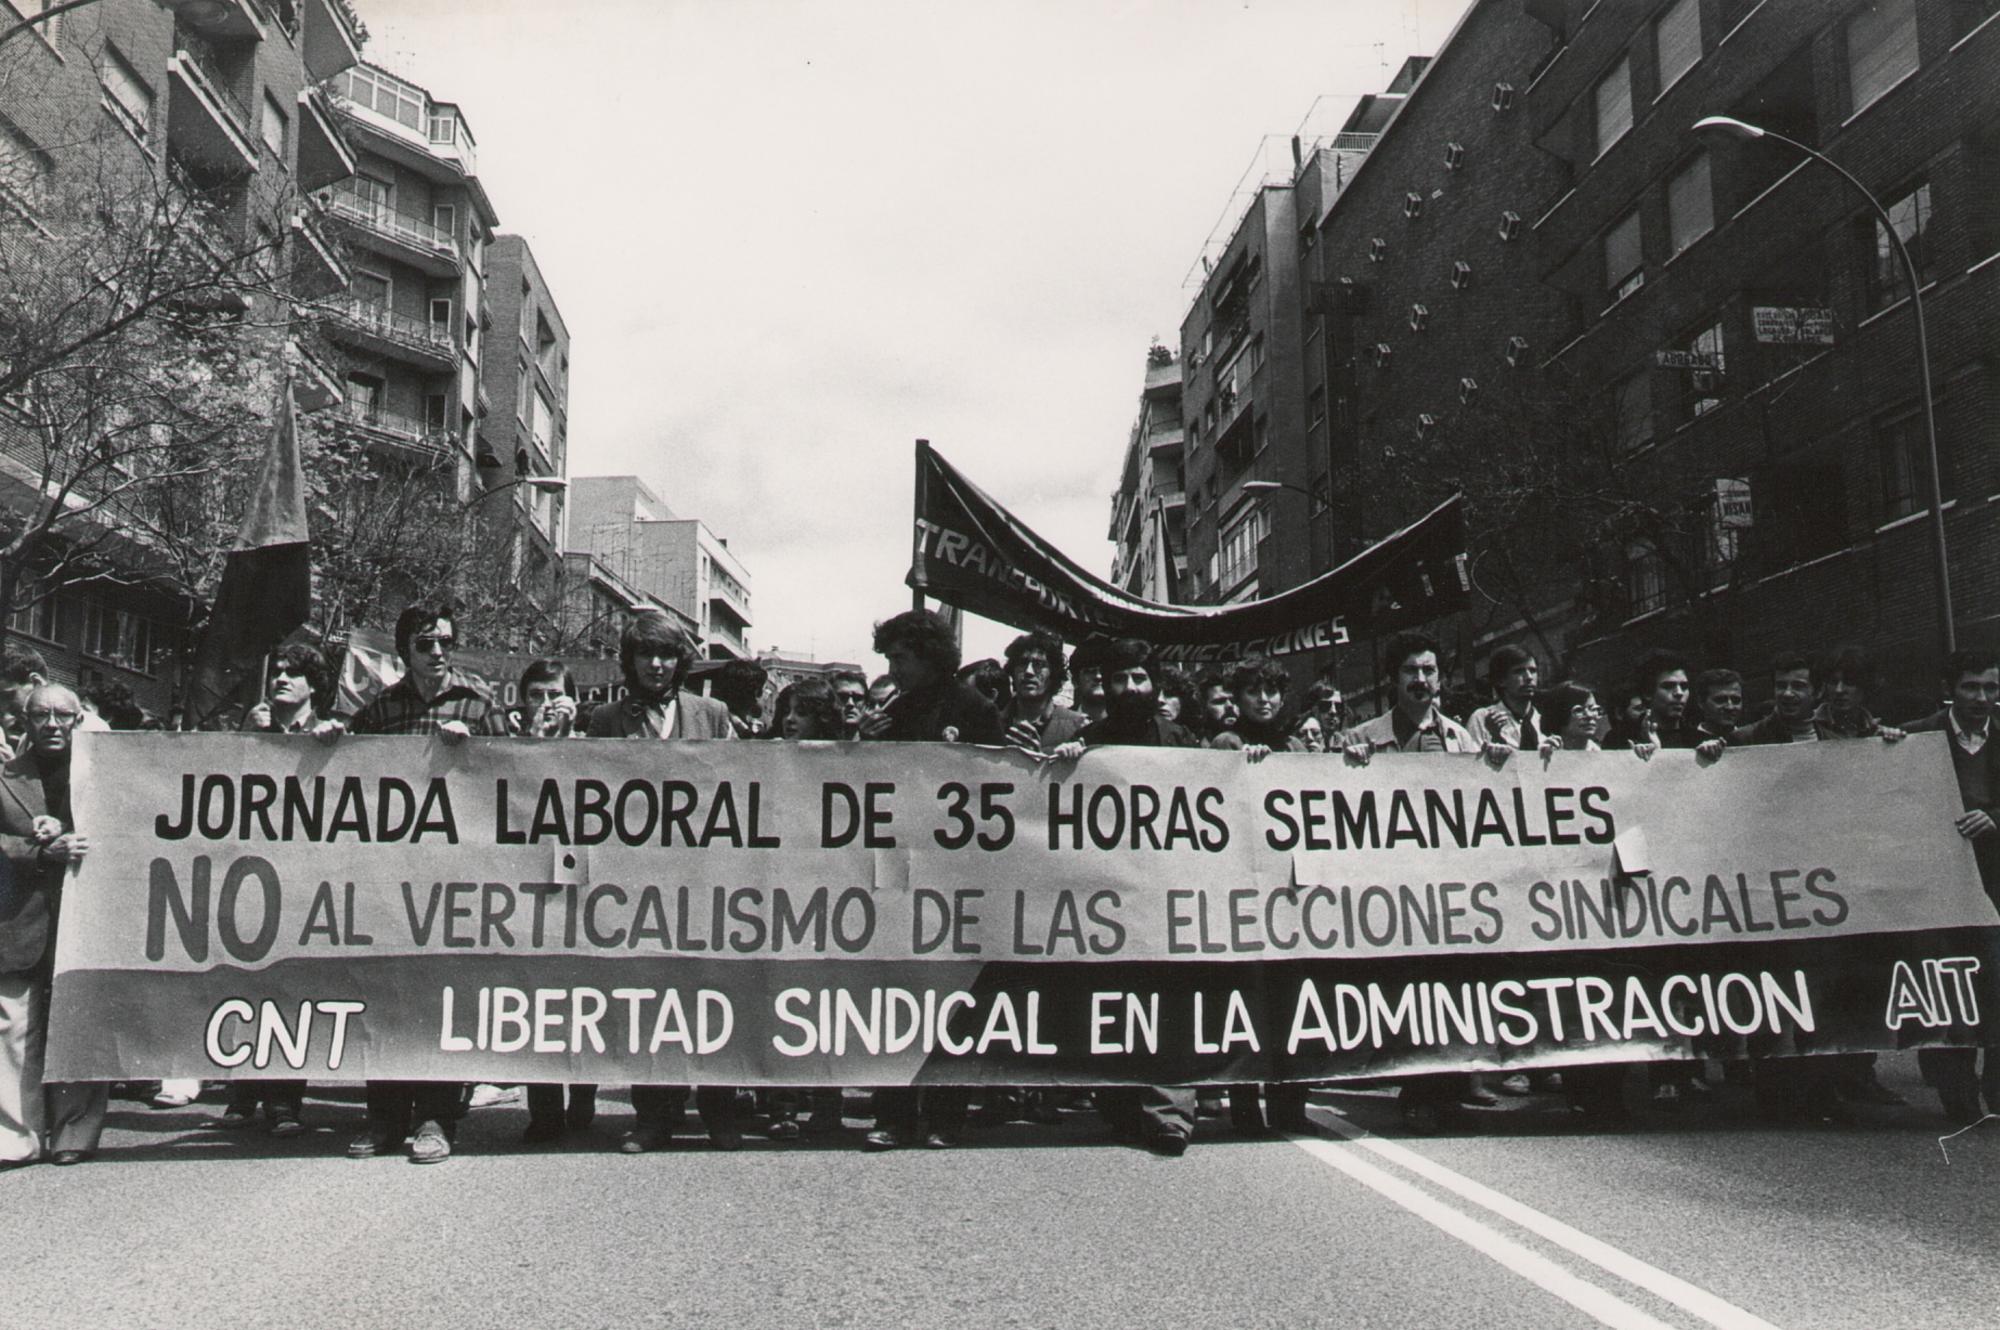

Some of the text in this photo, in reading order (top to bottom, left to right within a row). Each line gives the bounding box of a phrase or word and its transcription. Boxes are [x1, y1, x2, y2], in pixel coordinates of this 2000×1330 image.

[915, 517, 1122, 629] TRANSPORTE
[154, 773, 1617, 853] JORNADA LABORAL DE 35 HORAS SEMANALES
[144, 855, 1849, 963] NO AL VERTICALISMO DE LAS ELECCIONES SINDICALES
[204, 956, 1980, 1070] CNT LIBERTAD SINDICAL EN LA ADMINISTRACION AIT
